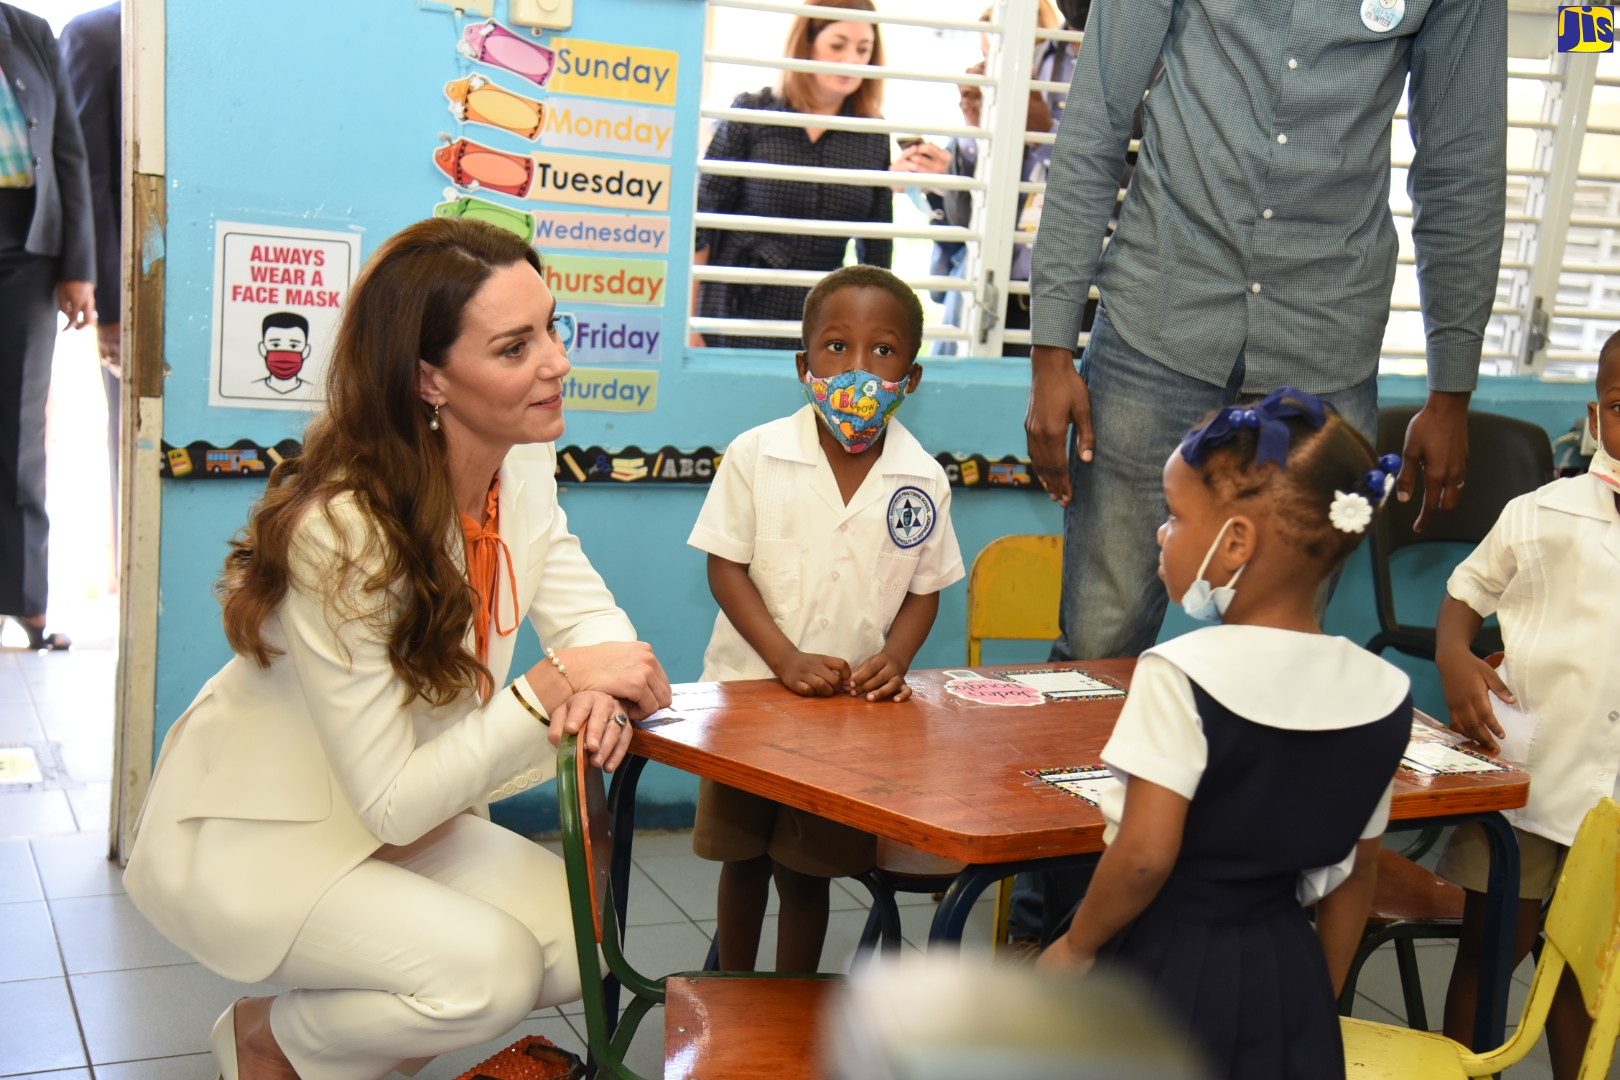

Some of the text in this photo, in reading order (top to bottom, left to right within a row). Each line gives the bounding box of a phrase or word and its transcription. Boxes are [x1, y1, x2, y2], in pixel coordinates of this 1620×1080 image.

[556, 48, 670, 91] Sunday
[545, 107, 671, 150] Monday
[538, 163, 663, 198] Tuesday
[536, 219, 665, 248] Wednesday
[249, 244, 326, 267] ALWAYS
[250, 265, 324, 287] WEAR A
[541, 265, 664, 301] hursday
[231, 284, 341, 308] FACE MASK
[576, 322, 660, 353] Friday
[561, 377, 650, 405] turday
[856, 403, 875, 415] POW
[662, 458, 711, 478] ABC
